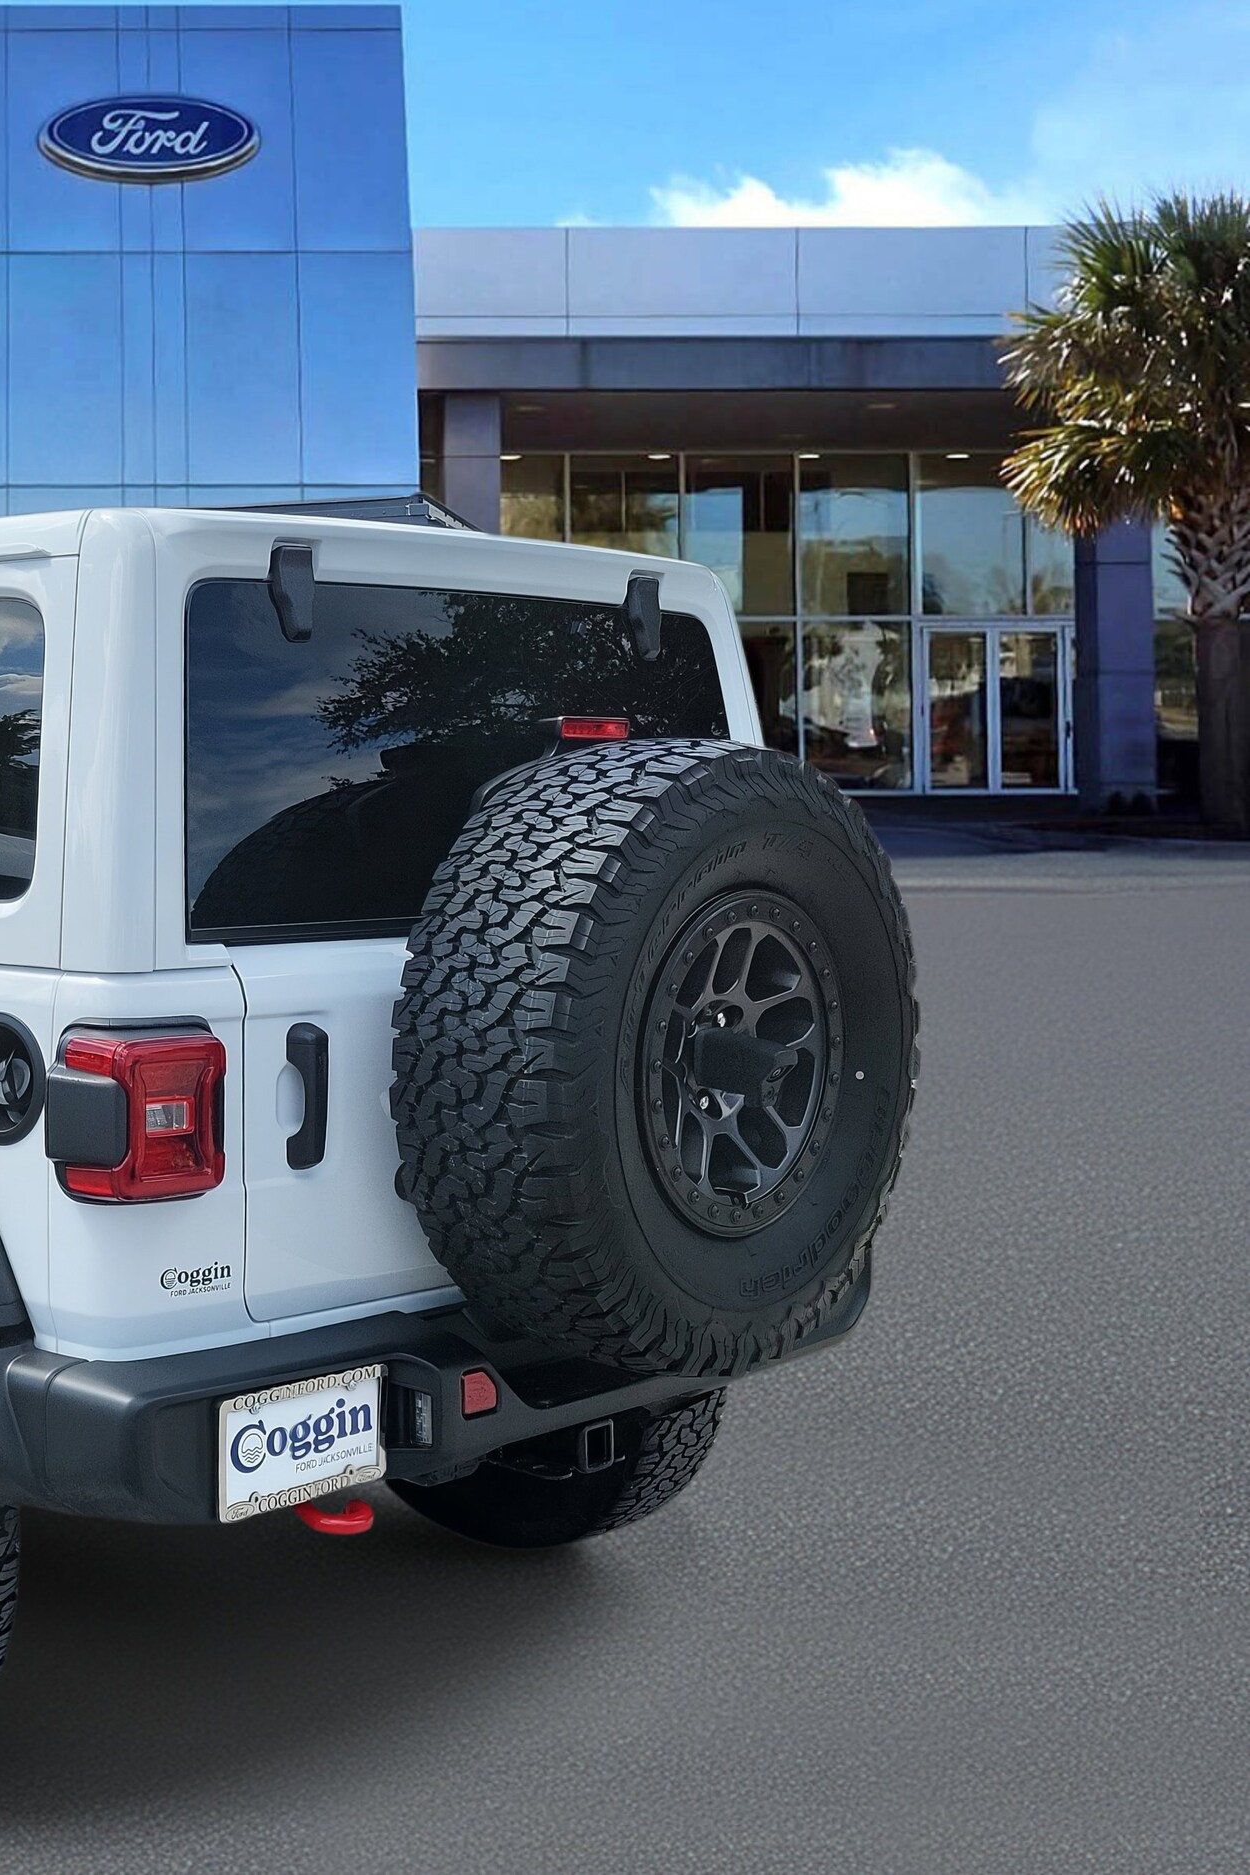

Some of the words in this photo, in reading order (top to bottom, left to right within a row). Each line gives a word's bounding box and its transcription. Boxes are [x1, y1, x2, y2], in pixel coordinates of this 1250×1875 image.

[91, 109, 210, 155] Ford
[160, 1261, 231, 1290] Coggin
[170, 1289, 187, 1297] FORD
[188, 1282, 231, 1295] JACKSONVILLE
[233, 1364, 377, 1411] COGGINFORD.COM
[230, 1398, 372, 1474] Coggin
[295, 1458, 317, 1473] FORD
[318, 1443, 373, 1466] JACKSONVILLE
[258, 1484, 312, 1513] COGGIN
[313, 1475, 350, 1497] FORD
